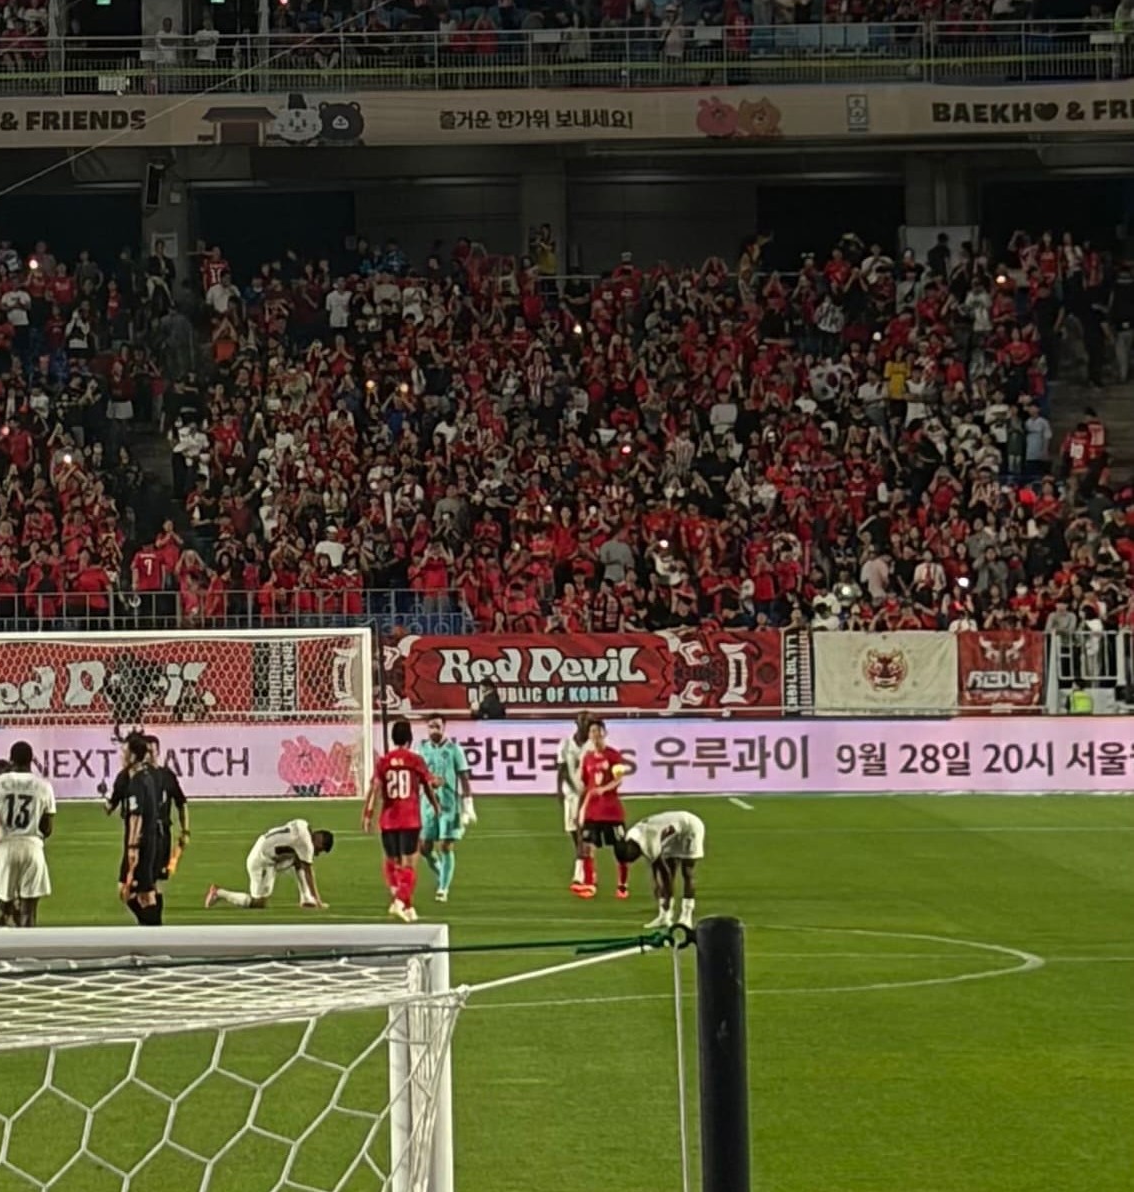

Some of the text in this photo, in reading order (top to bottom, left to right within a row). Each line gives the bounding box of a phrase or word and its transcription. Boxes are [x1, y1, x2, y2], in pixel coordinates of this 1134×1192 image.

[0, 112, 19, 132] &
[26, 109, 146, 131] FRIENDS
[439, 108, 633, 130] 즐거운 한가위 보내세요!
[1066, 101, 1085, 121] &
[437, 648, 521, 683] Red
[546, 686, 565, 703] OF
[569, 686, 618, 703] KOREA
[165, 746, 250, 777] ATCH
[651, 734, 809, 780] 우루과이
[836, 742, 888, 776] 9월
[899, 742, 971, 776] 28일
[983, 742, 1055, 777] 20시
[1066, 741, 1134, 777] 서울
[4, 793, 34, 830] 13
